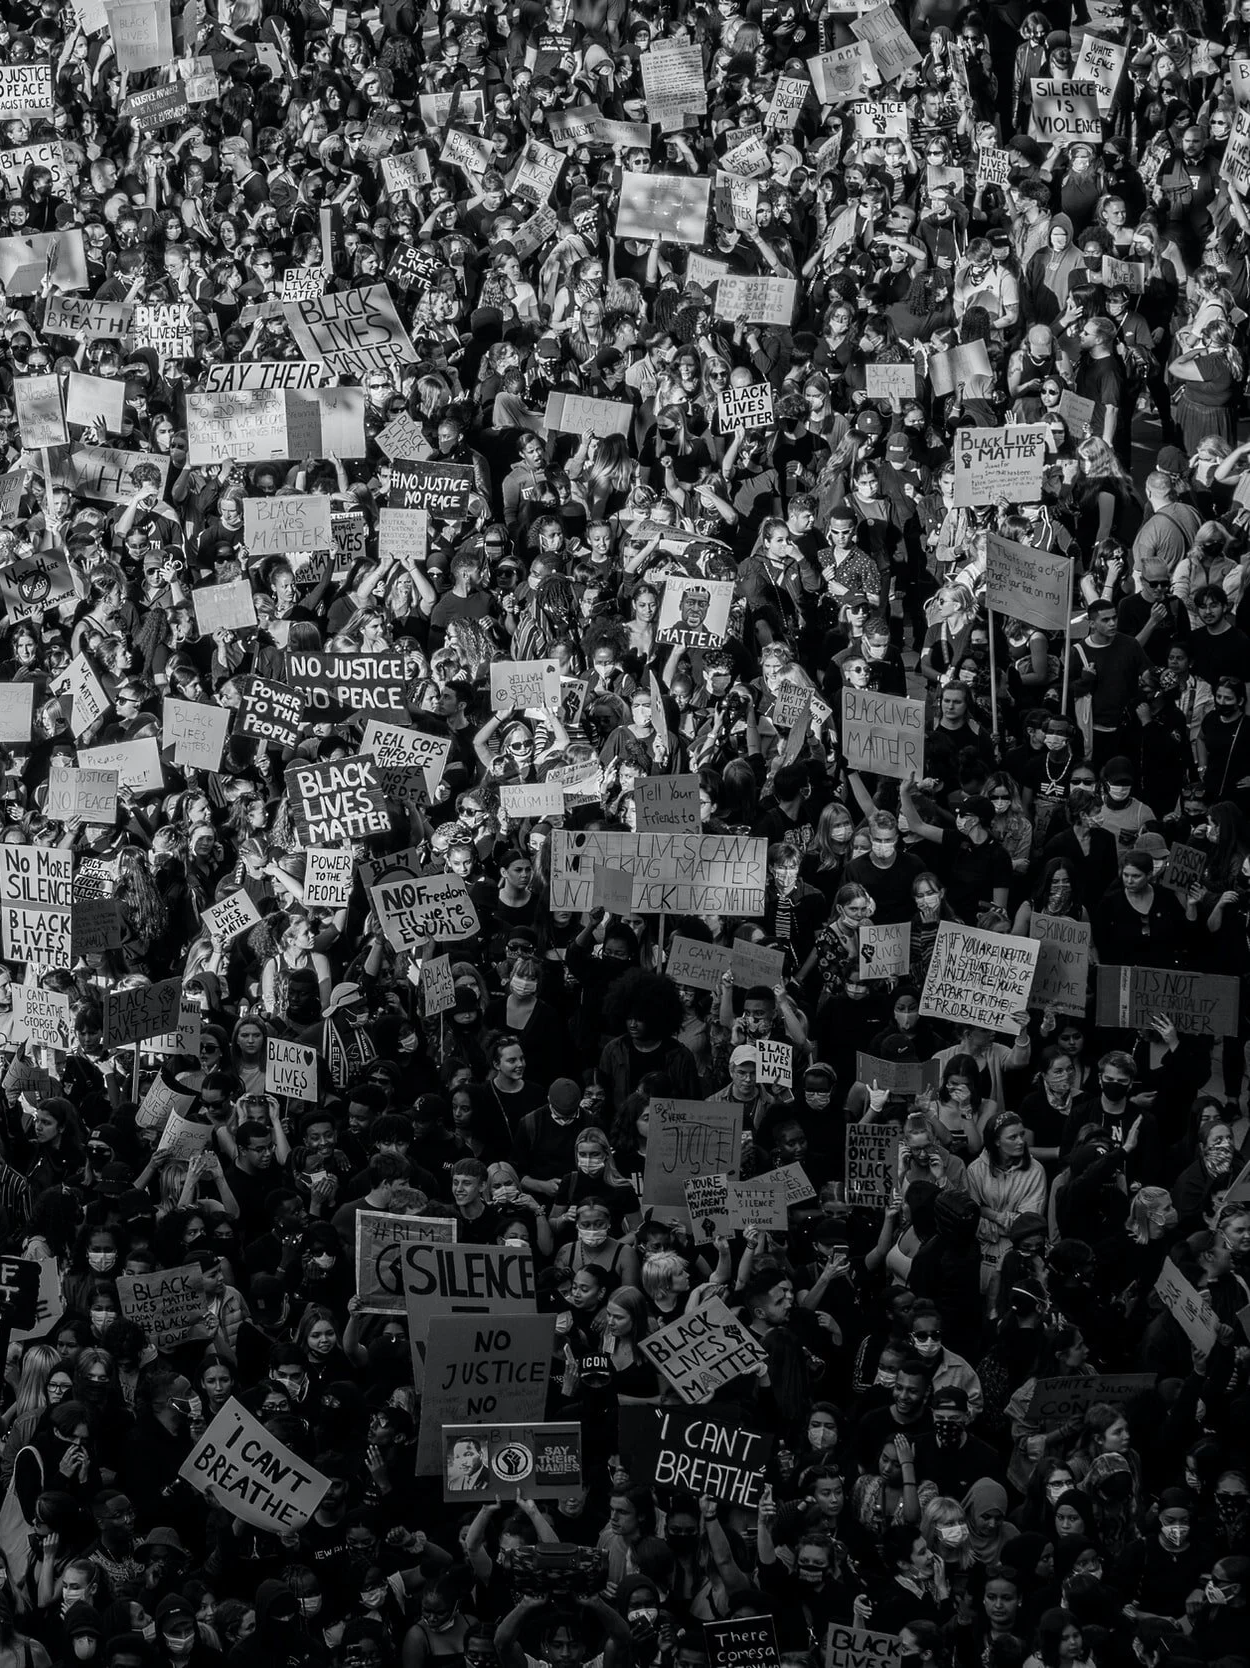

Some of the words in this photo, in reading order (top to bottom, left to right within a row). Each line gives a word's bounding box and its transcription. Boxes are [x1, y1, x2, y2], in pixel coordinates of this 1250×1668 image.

[6, 66, 51, 83] JUSTICE
[6, 84, 44, 97] PEACE
[1037, 81, 1097, 97] SILENCE
[24, 98, 51, 108] POLICE
[855, 102, 903, 115] JUSTICE
[1057, 100, 1074, 113] IS
[1037, 118, 1100, 134] VIOLENCE
[981, 148, 1007, 160] BLACK
[980, 167, 1008, 184] MATTER
[981, 158, 1007, 172] LIVES
[298, 288, 379, 326] BLACK
[310, 314, 392, 355] LIVES
[322, 344, 409, 377] MATTER
[722, 384, 769, 403] BLACK
[726, 400, 765, 416] LIVES
[721, 412, 773, 432] MATTER
[290, 656, 321, 678] NO
[325, 659, 402, 681] JUSTICE
[251, 680, 300, 711] POWER
[296, 687, 328, 708] NO
[337, 688, 403, 710] PEACE
[243, 696, 267, 712] TO
[272, 705, 300, 724] THE
[243, 714, 296, 747] PEOPLE
[298, 762, 376, 797] BLACK
[303, 787, 374, 820] LIVES
[308, 810, 390, 842] MATTER
[311, 856, 350, 870] POWER
[316, 872, 325, 881] TO
[326, 872, 340, 881] THE
[6, 875, 71, 905] SILENCE
[308, 884, 346, 903] PEOPLE
[212, 897, 239, 919] BLACK
[9, 910, 71, 930] BLACK
[214, 908, 241, 930] LIVES
[222, 914, 251, 937] MATTER
[10, 929, 65, 950] LIVES
[10, 943, 68, 967] MATTER
[268, 1042, 302, 1064] BLACK
[273, 1065, 308, 1089] LIVES
[276, 1086, 303, 1096] MATTER
[849, 1125, 870, 1136] ALL
[871, 1126, 898, 1137] LIVES
[848, 1137, 890, 1148] MATTER
[848, 1148, 885, 1160] ONCE
[848, 1162, 892, 1179] BLACK
[848, 1180, 876, 1191] LIVES
[848, 1192, 889, 1206] MATTER
[406, 1246, 536, 1299] SILENCE
[475, 1331, 511, 1353] NO
[647, 1312, 720, 1362] BLACK
[664, 1336, 728, 1380] LIVES
[442, 1360, 546, 1389] JUSTICE
[684, 1342, 766, 1403] MATTER
[468, 1396, 497, 1416] NO
[684, 1422, 761, 1462] CAN'T
